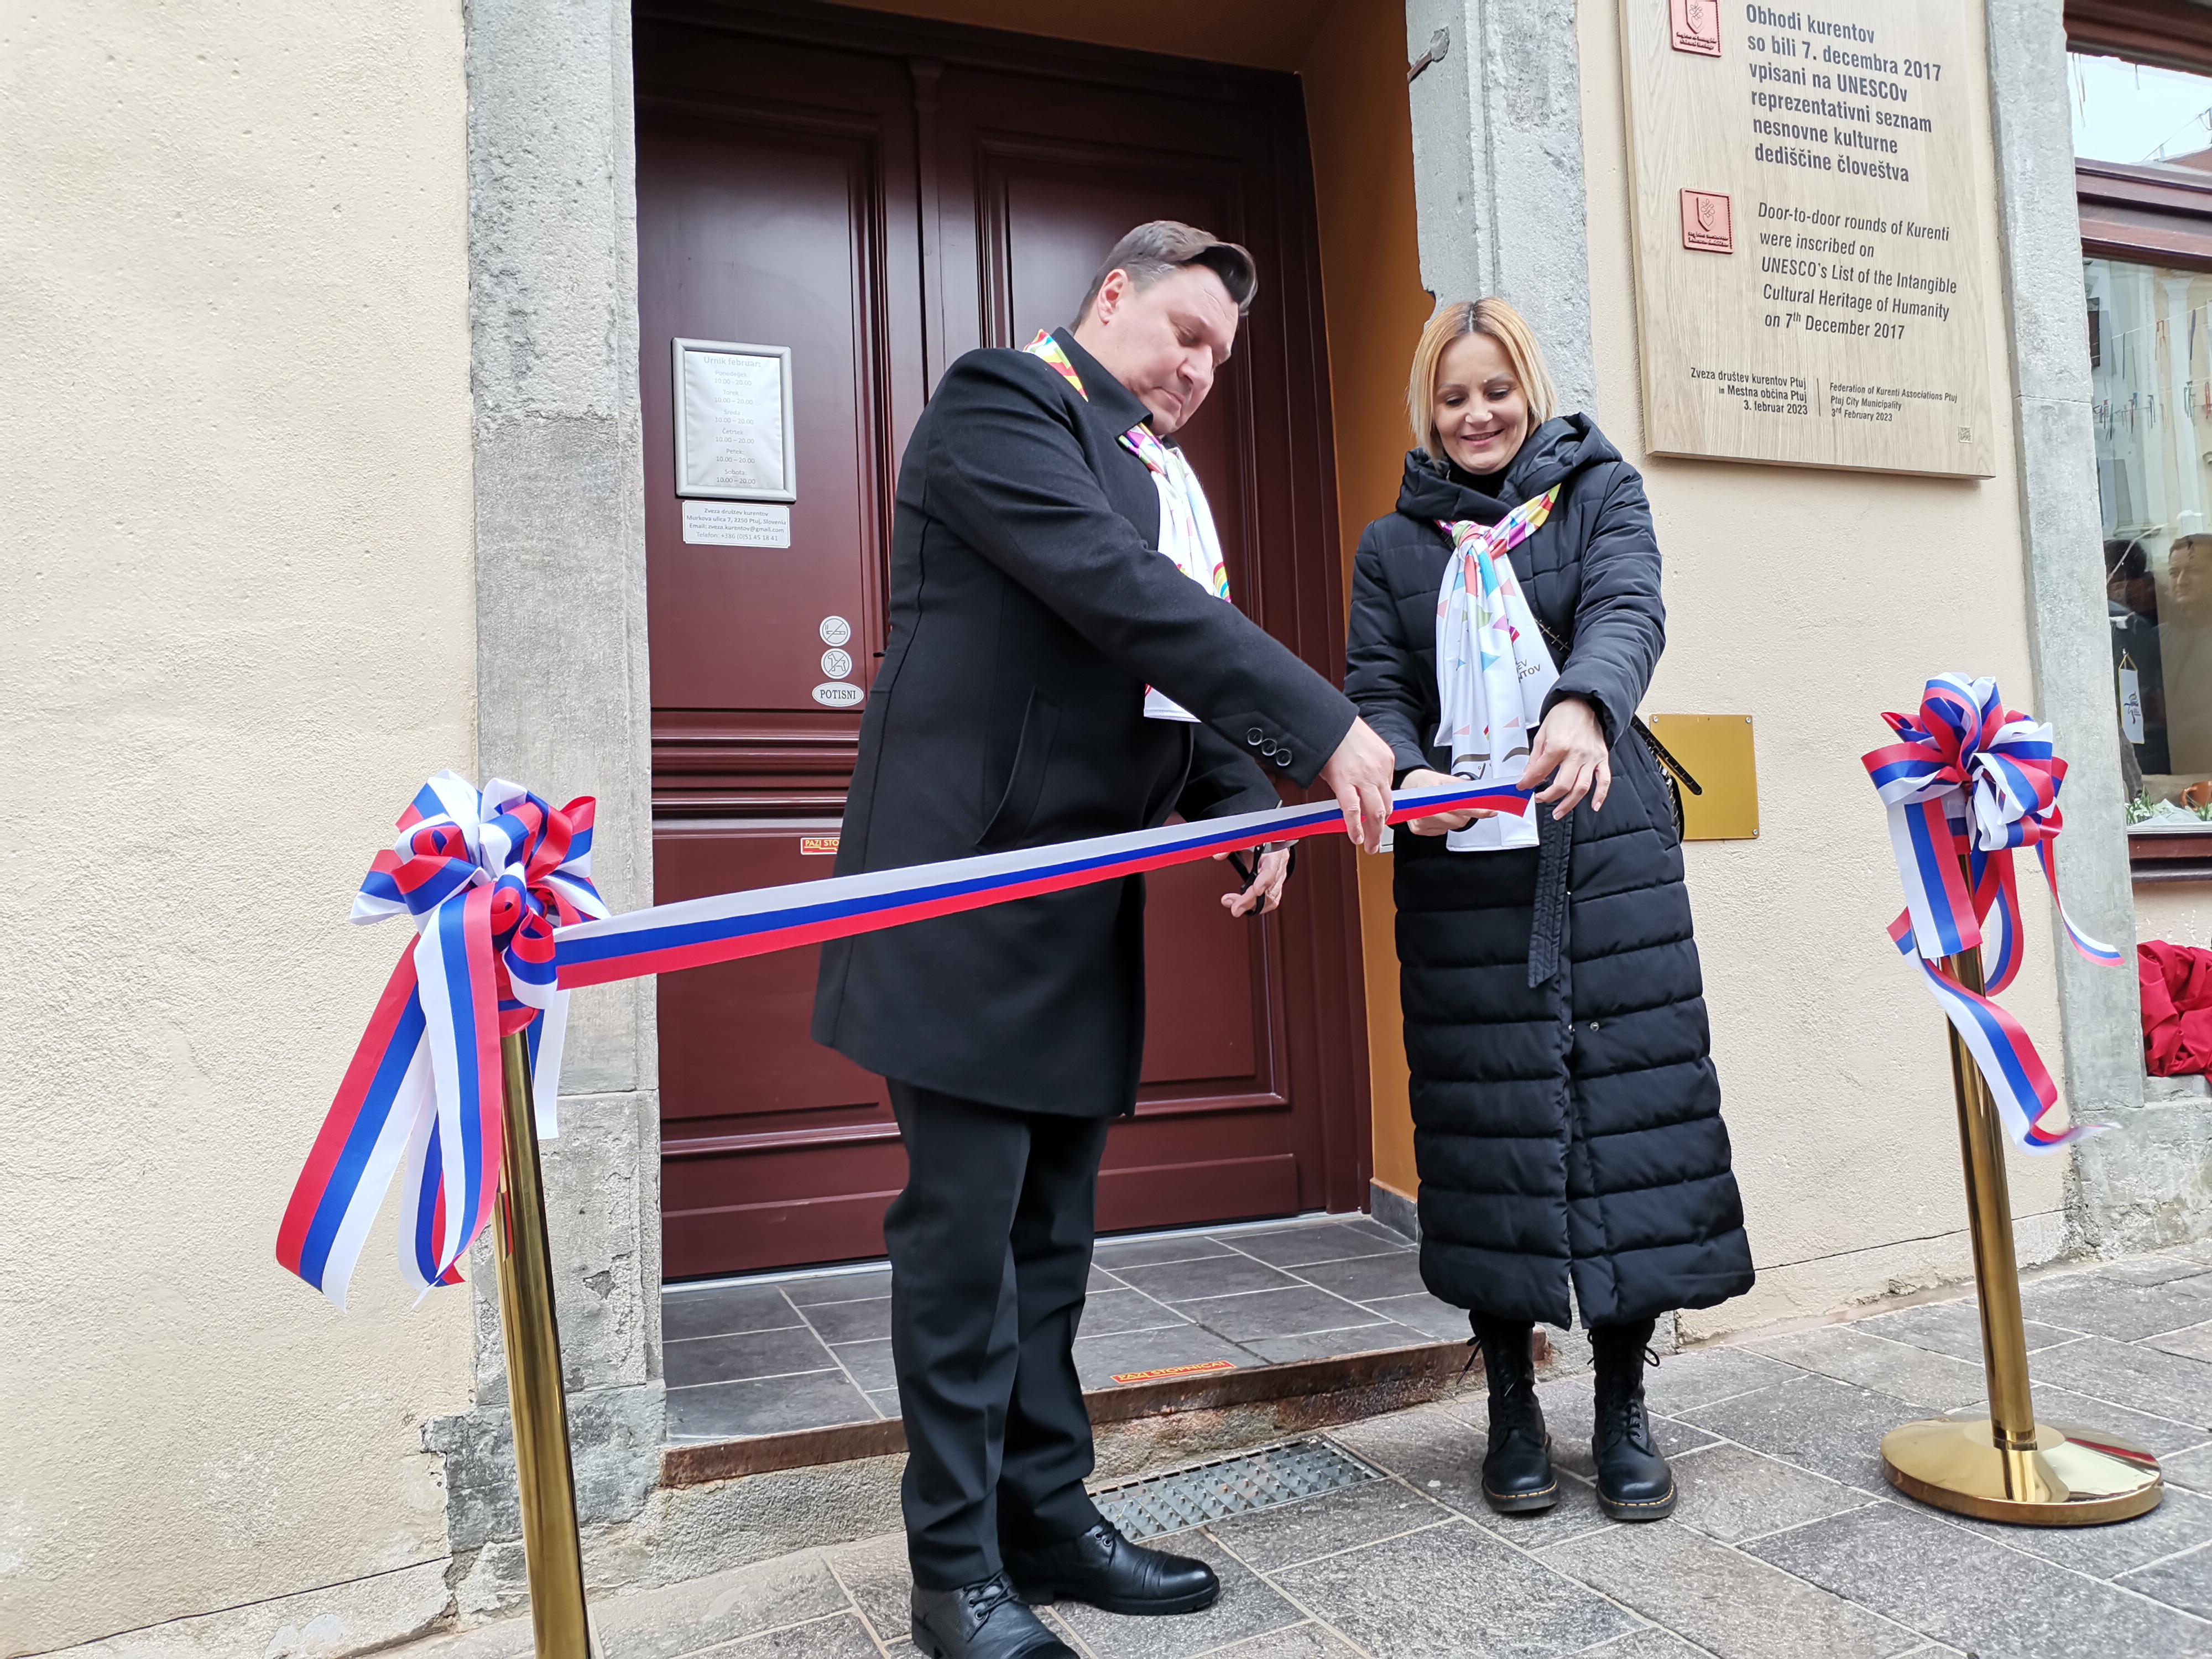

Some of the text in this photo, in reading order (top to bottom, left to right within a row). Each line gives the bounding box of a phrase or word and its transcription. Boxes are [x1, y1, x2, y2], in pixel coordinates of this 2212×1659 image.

[1746, 4, 1874, 44] Obhodi kurentov
[1747, 35, 1941, 81] so bili 7. decembra 2017
[1749, 61, 1907, 102] vpisani na UNESCOv
[1751, 91, 1932, 133] reprezentativni seznam
[1753, 118, 1897, 153] nesnovne kulturne
[1755, 143, 1909, 182] dediščine človeštva
[1758, 202, 1949, 241] Door-to-door rounds of Kurenti
[1760, 232, 1875, 257] were inscribed on
[1832, 264, 1854, 281] List
[1858, 268, 1870, 283] of
[1874, 270, 1892, 286] the
[1897, 272, 1957, 294] Intangible
[1764, 283, 1949, 322] Cultural Heritage of Humanity
[1765, 314, 1780, 327] on
[1806, 315, 1870, 336] December
[1874, 322, 1905, 340] 2017
[703, 357, 761, 367] Urnik februar:
[715, 370, 747, 378] Ponedeljek
[1691, 367, 1806, 390] Zveza društev kurentov Ptuj
[1719, 384, 1807, 404] in Mestna občina Ptuj
[1830, 382, 1958, 404] Federation of Kurenti Associations Ptuj
[1830, 395, 1902, 411] Ptuj City Municipality
[1744, 400, 1808, 415] 3. februar 2023
[1844, 409, 1874, 421] February
[1876, 412, 1892, 421] 2023
[708, 524, 784, 533] zveza.kurentov@gmail.com
[820, 690, 856, 700] POTISNI
[1118, 1371, 1148, 1380] PAZI
